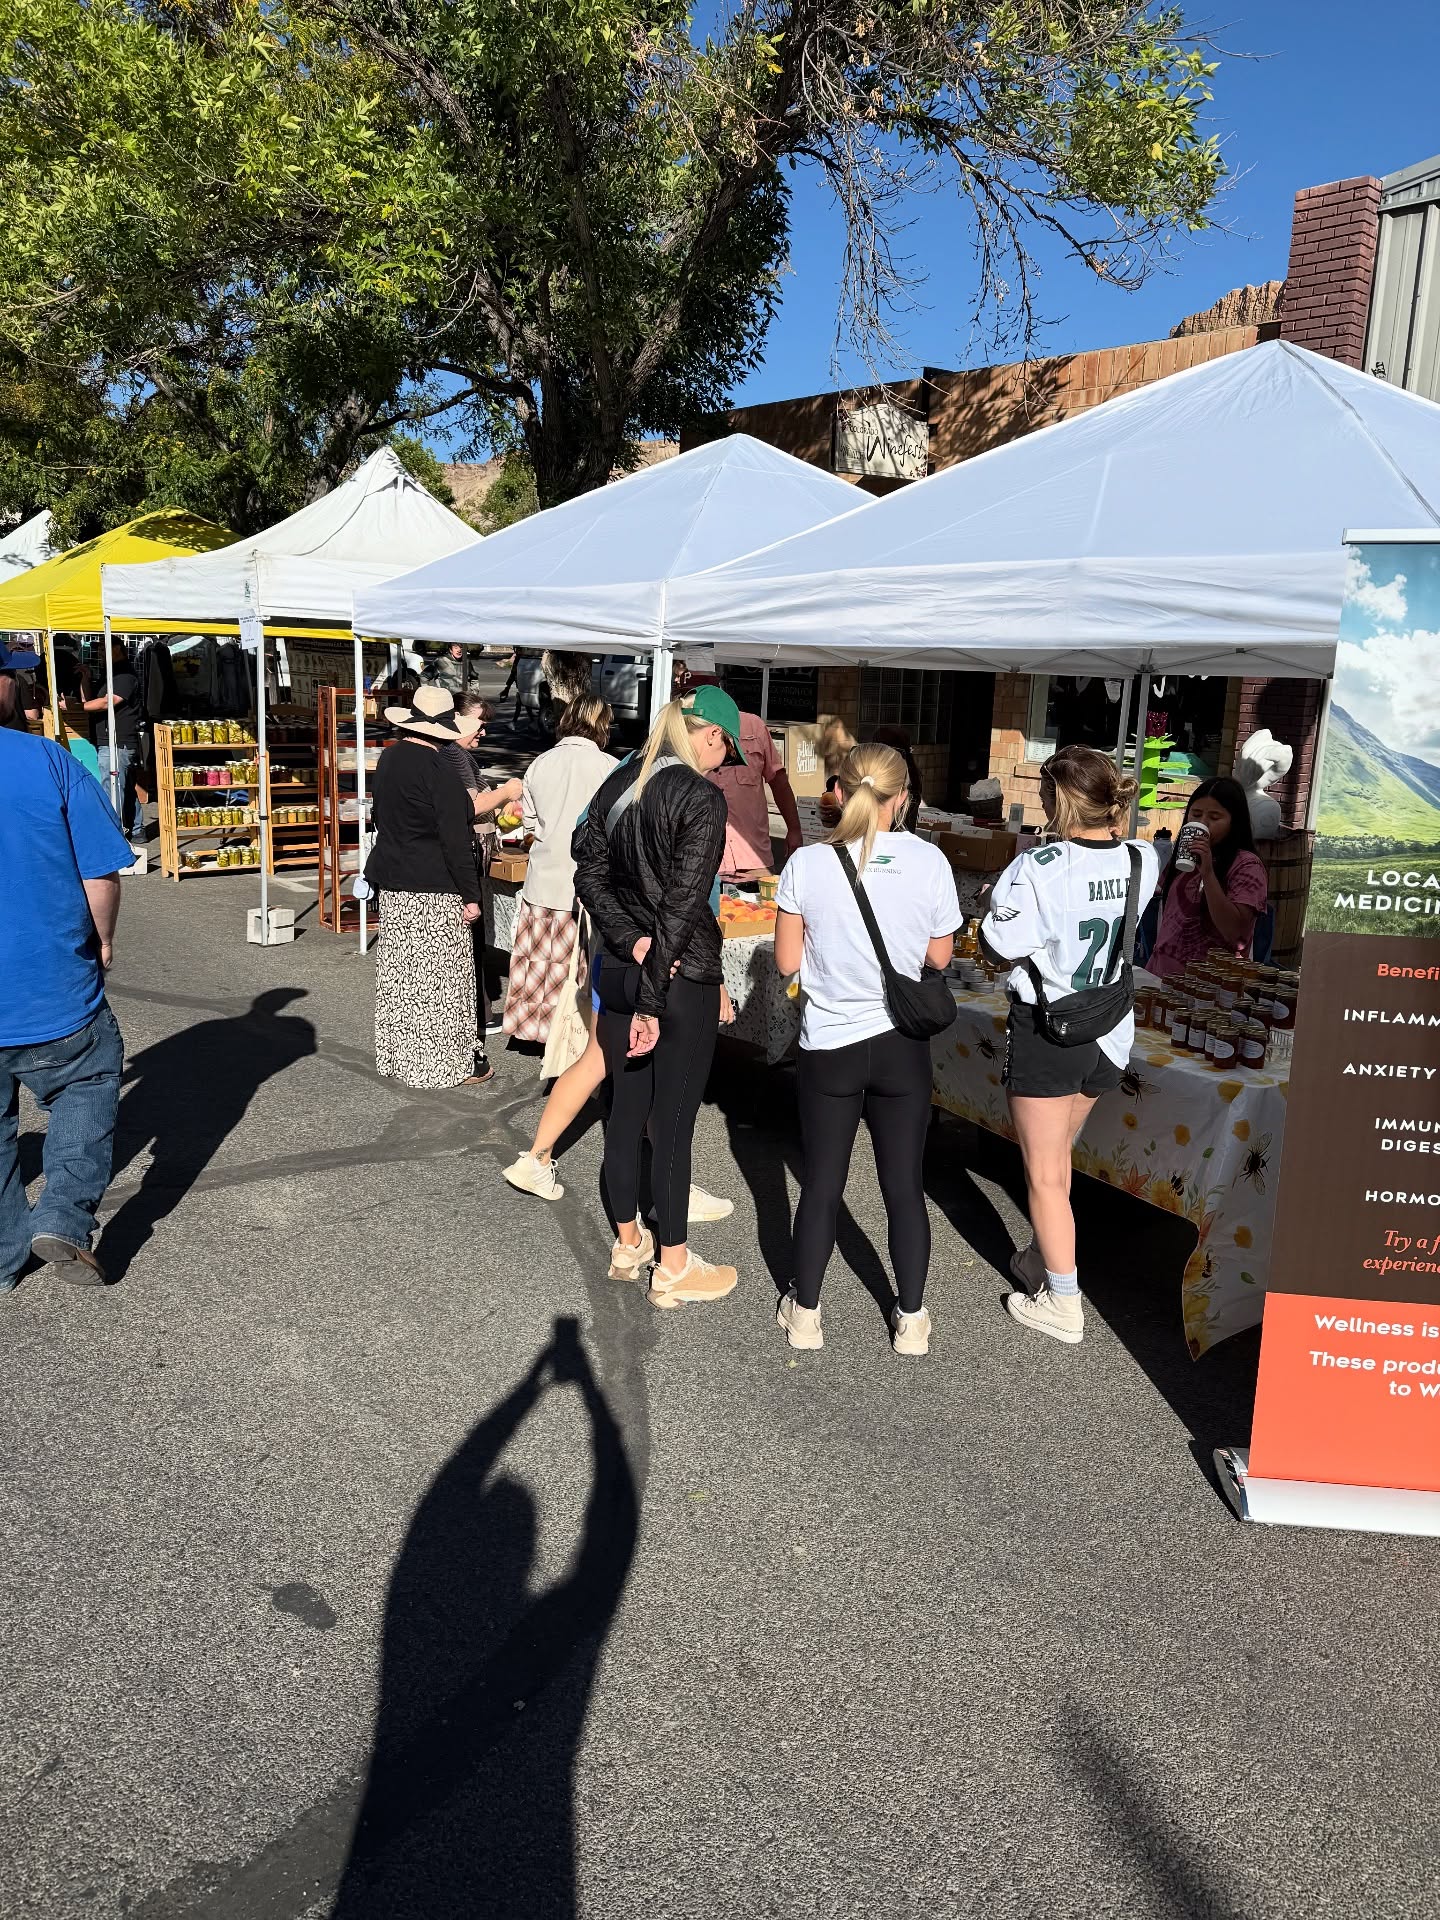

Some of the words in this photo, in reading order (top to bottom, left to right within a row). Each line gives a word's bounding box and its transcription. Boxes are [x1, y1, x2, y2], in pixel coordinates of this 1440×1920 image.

[683, 671, 692, 684] P
[1367, 870, 1440, 889] LOCA
[1377, 963, 1440, 981] Benefi
[1342, 1062, 1437, 1080] ANXIETY
[1380, 1138, 1440, 1155] DIGES
[1365, 1190, 1440, 1206] HORMO
[1384, 1229, 1412, 1253] Try
[1416, 1238, 1428, 1249] a
[1314, 1314, 1415, 1337] Wellness
[1421, 1321, 1440, 1338] is
[1309, 1350, 1377, 1370] These
[1382, 1359, 1440, 1375] prod
[1389, 1380, 1412, 1396] to
